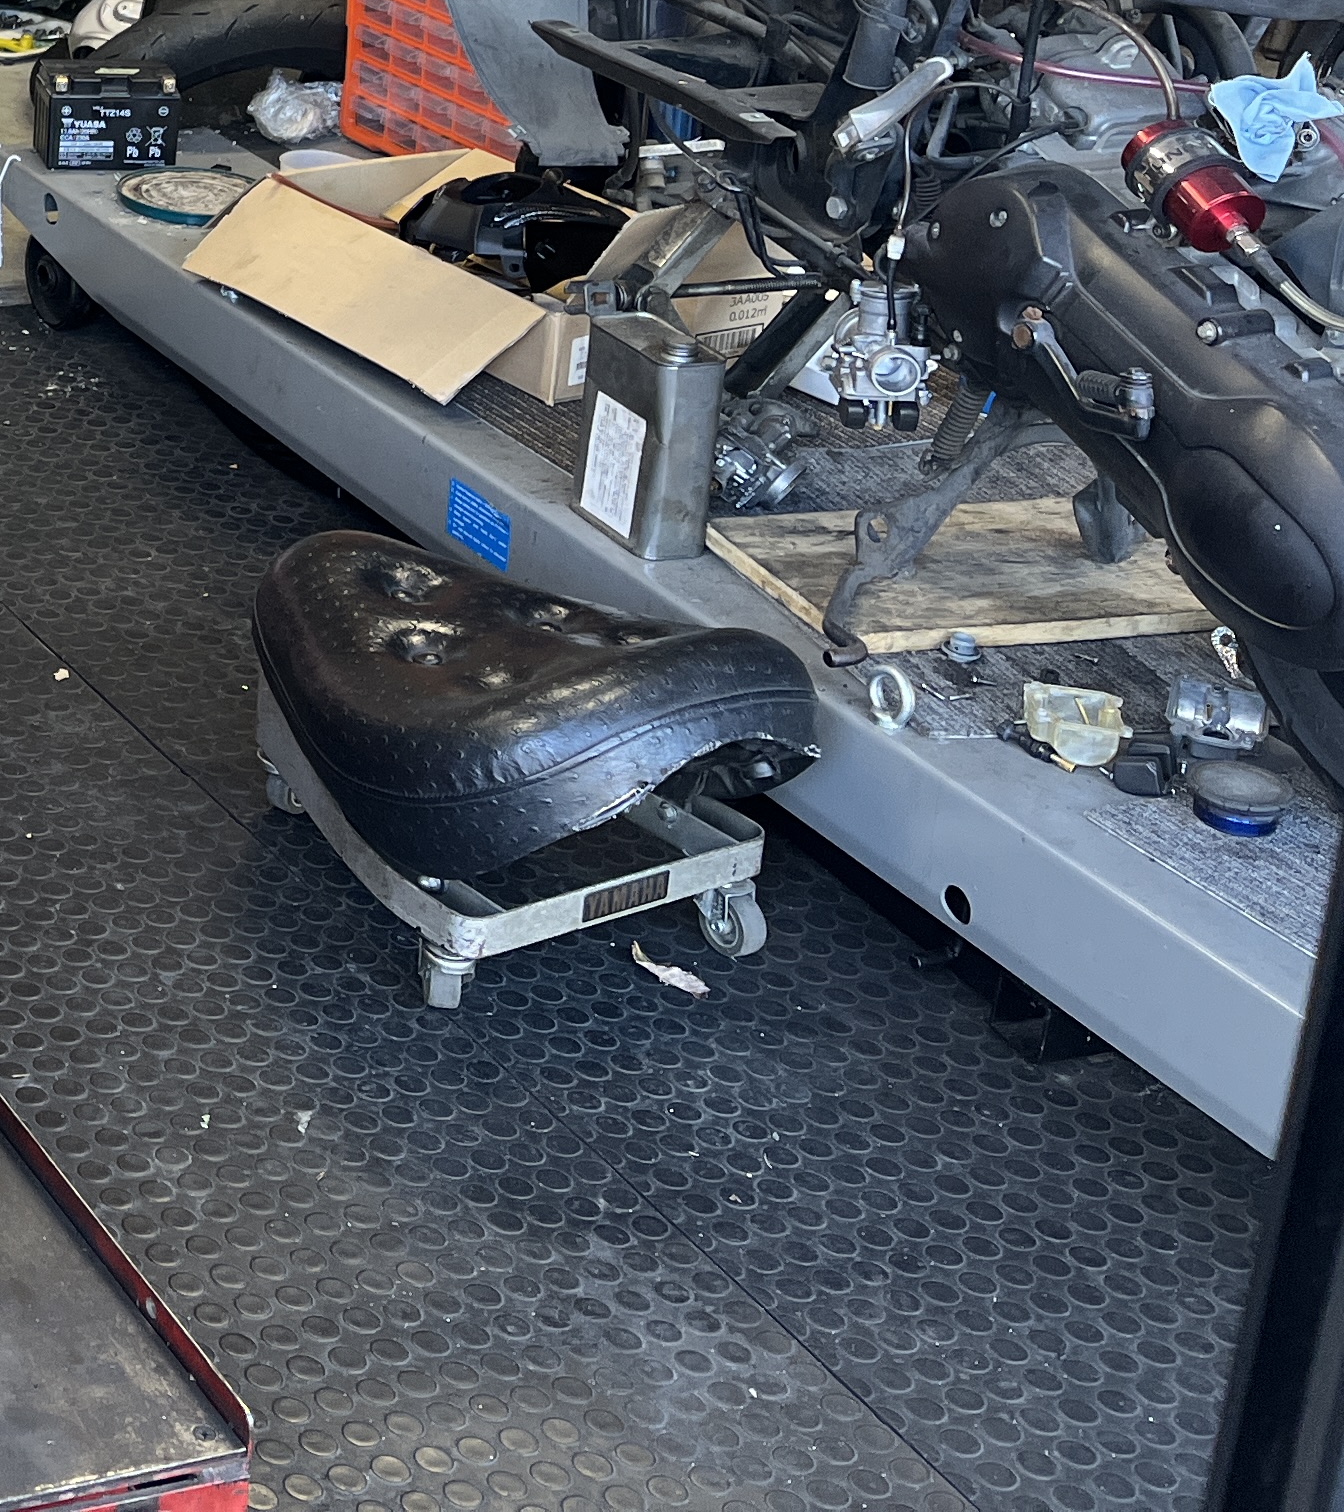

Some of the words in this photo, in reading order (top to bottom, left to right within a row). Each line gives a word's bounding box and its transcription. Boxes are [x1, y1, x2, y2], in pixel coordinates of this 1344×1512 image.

[74, 120, 107, 128] YUASA
[126, 146, 140, 158] Pb
[148, 146, 162, 158] Pb
[588, 874, 666, 920] YAMAHA
